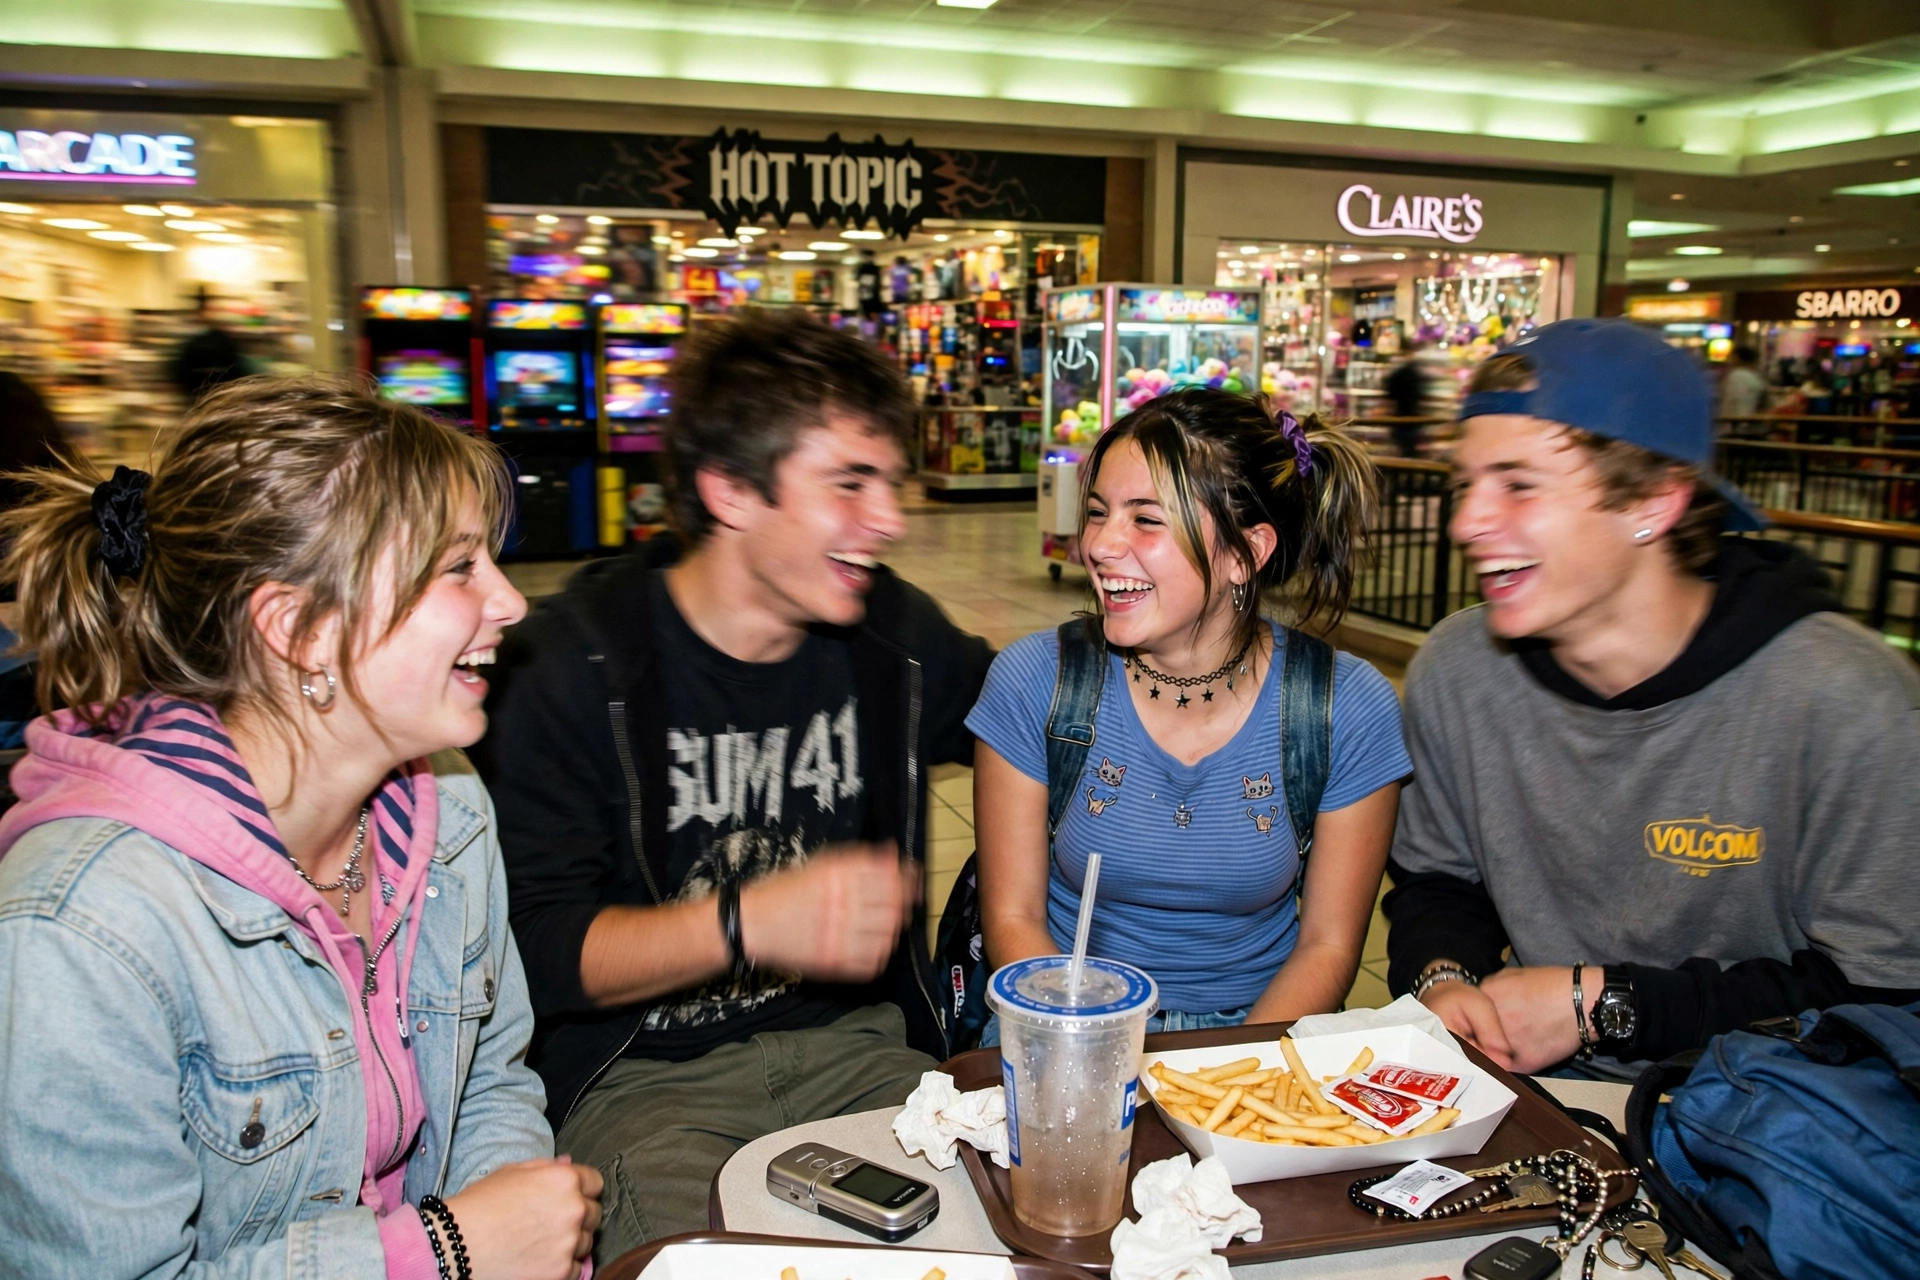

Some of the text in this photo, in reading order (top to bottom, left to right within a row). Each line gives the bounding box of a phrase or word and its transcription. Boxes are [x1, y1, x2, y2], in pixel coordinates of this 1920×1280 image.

[0, 130, 196, 176] ARCADE
[708, 143, 923, 216] HOT TOPIC
[1337, 184, 1483, 243] CLAIRE'S
[1796, 288, 1900, 318] SBARRO
[790, 695, 864, 814] 41
[1652, 826, 1758, 861] VOLCOM
